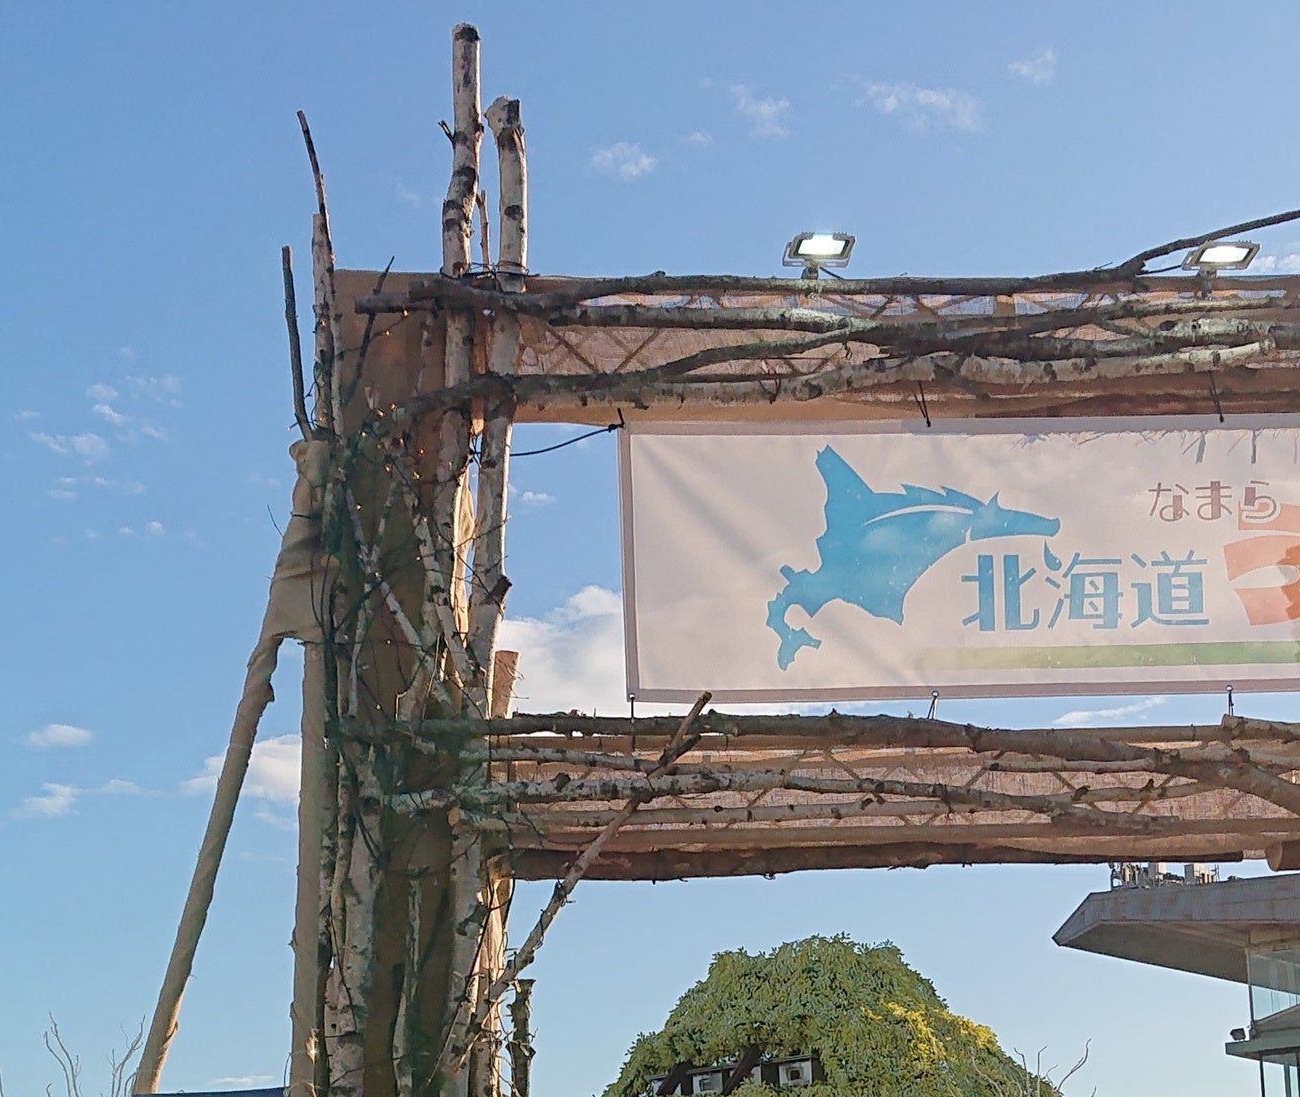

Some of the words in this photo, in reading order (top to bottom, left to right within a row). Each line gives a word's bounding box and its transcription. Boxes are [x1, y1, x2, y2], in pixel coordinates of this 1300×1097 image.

[1148, 480, 1278, 523] なまら
[960, 549, 1211, 632] 北海道
